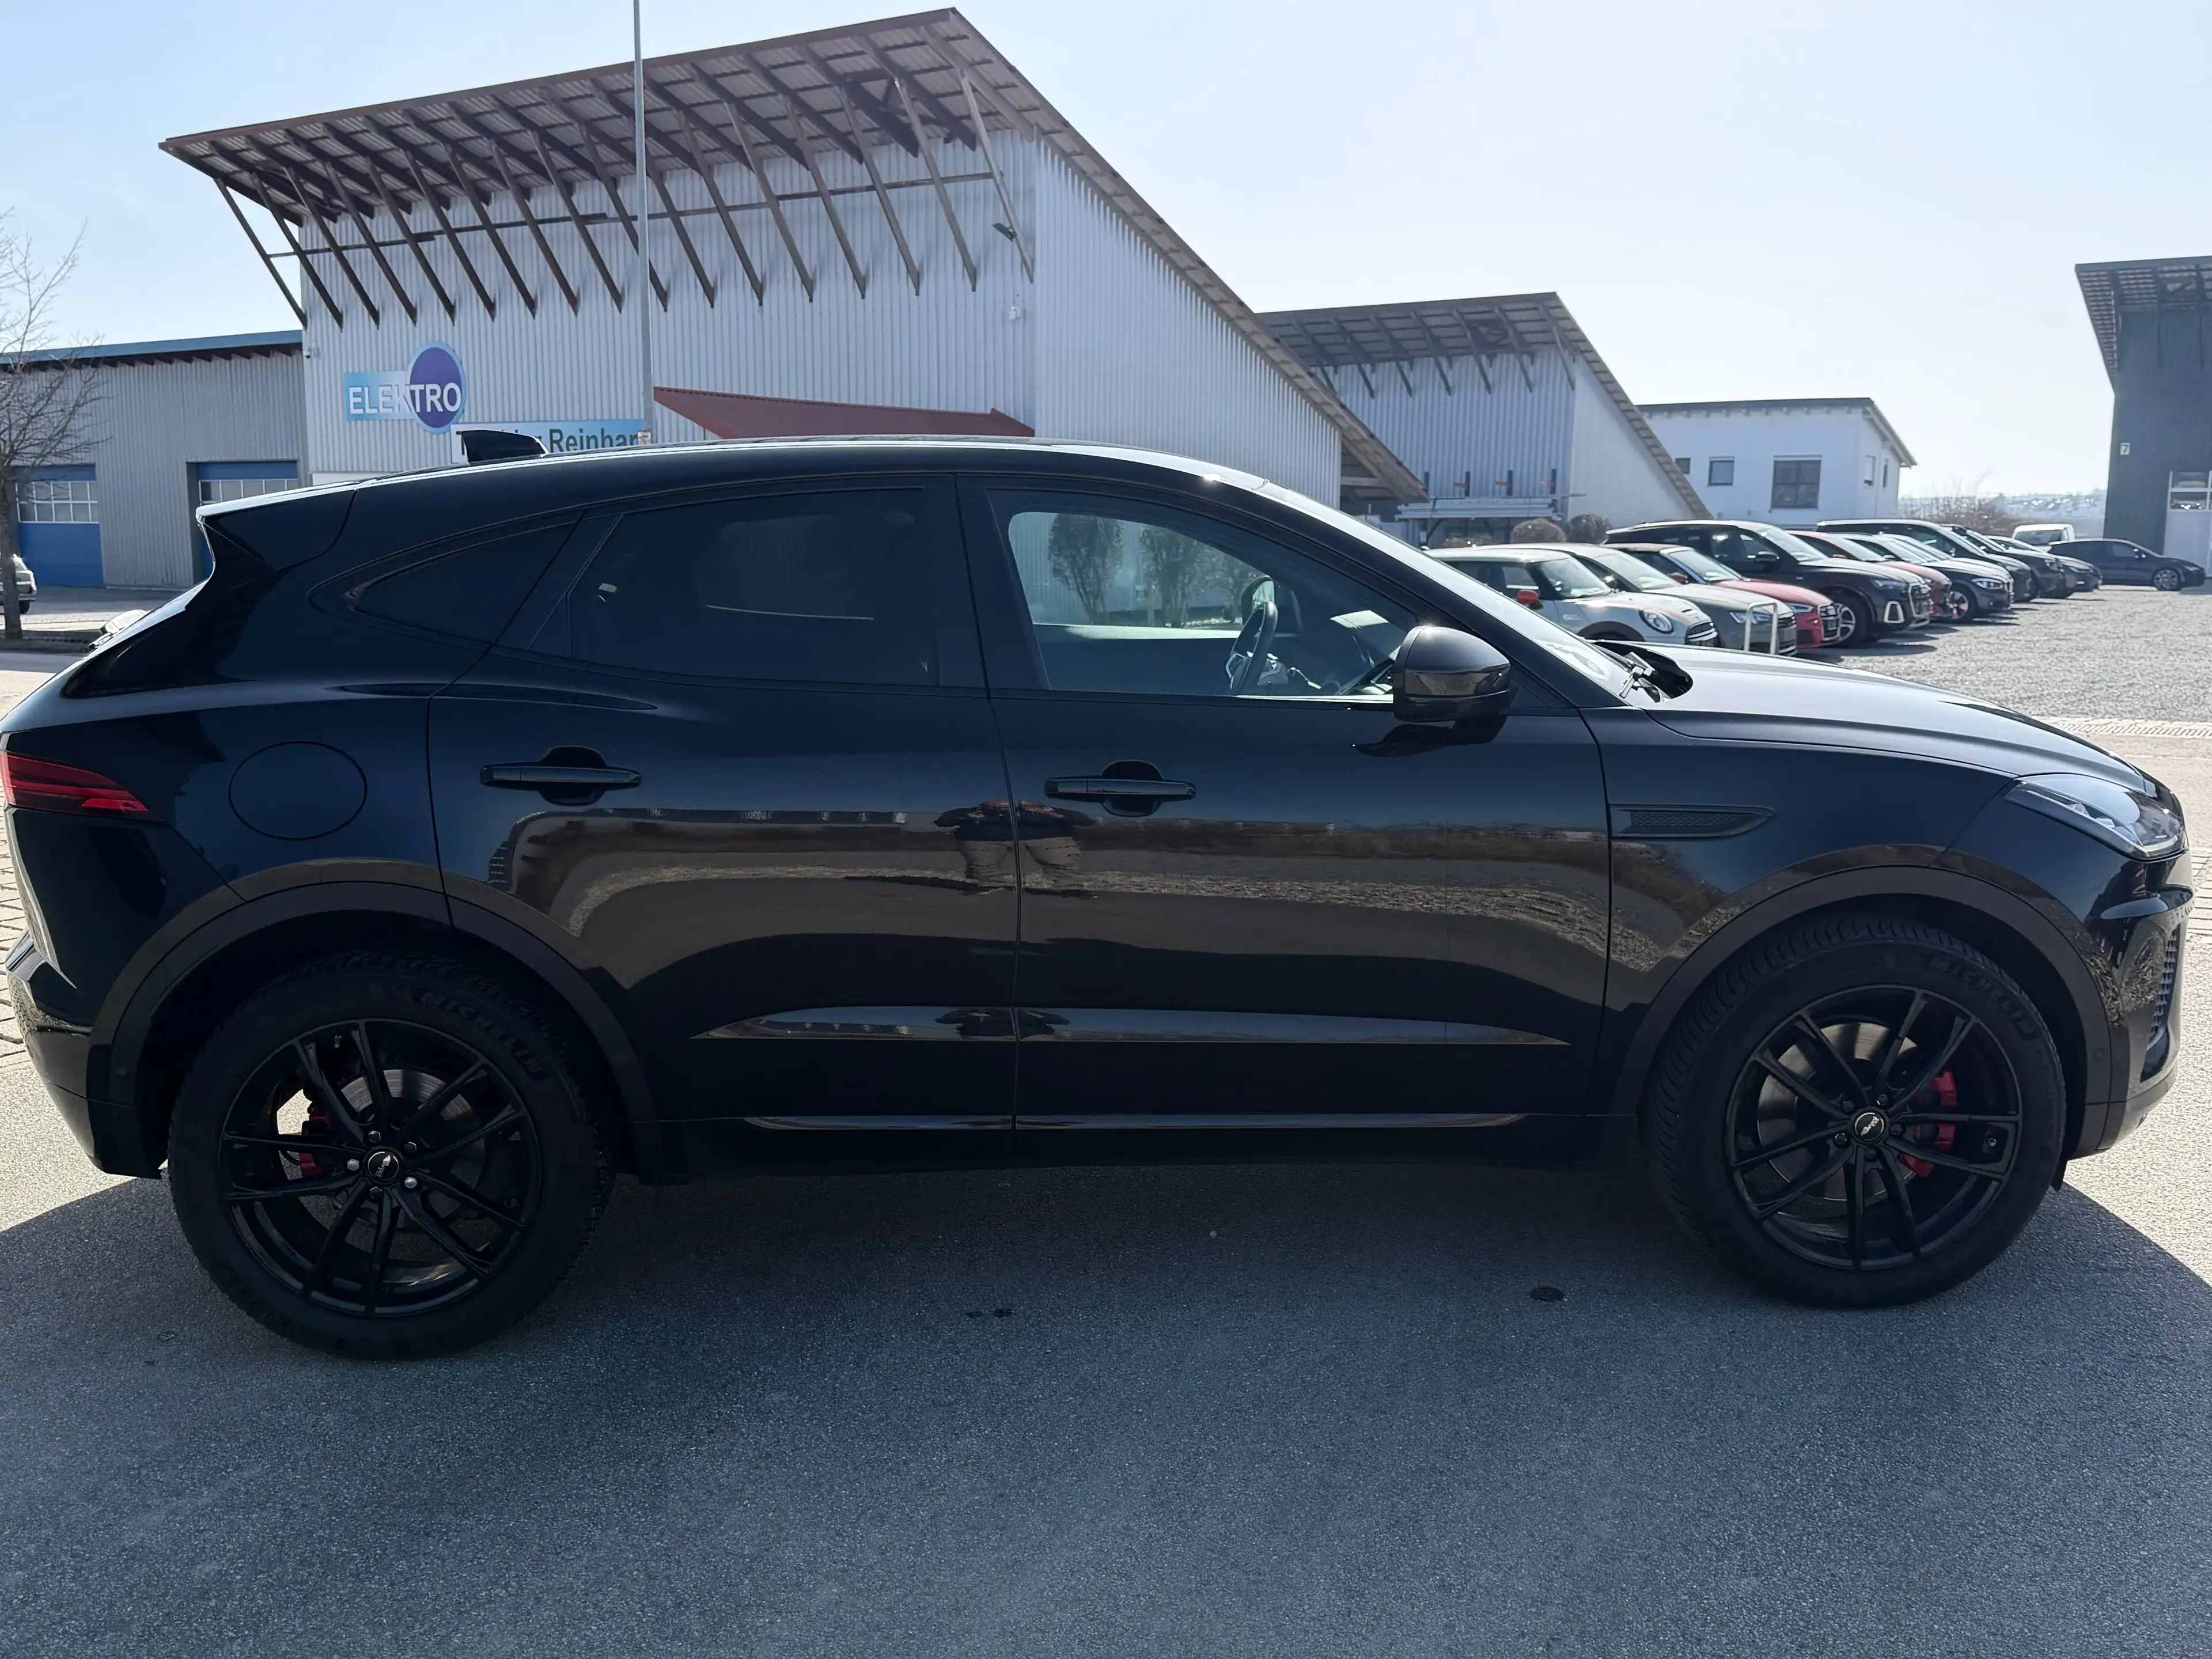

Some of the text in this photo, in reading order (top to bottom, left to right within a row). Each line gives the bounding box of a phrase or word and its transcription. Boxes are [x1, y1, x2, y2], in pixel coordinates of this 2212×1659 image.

[349, 382, 461, 414] ELEKTRO
[550, 428, 639, 453] Reinhar
[1928, 957, 2036, 1039] MICHELIN
[419, 991, 544, 1074] MICHELIN
